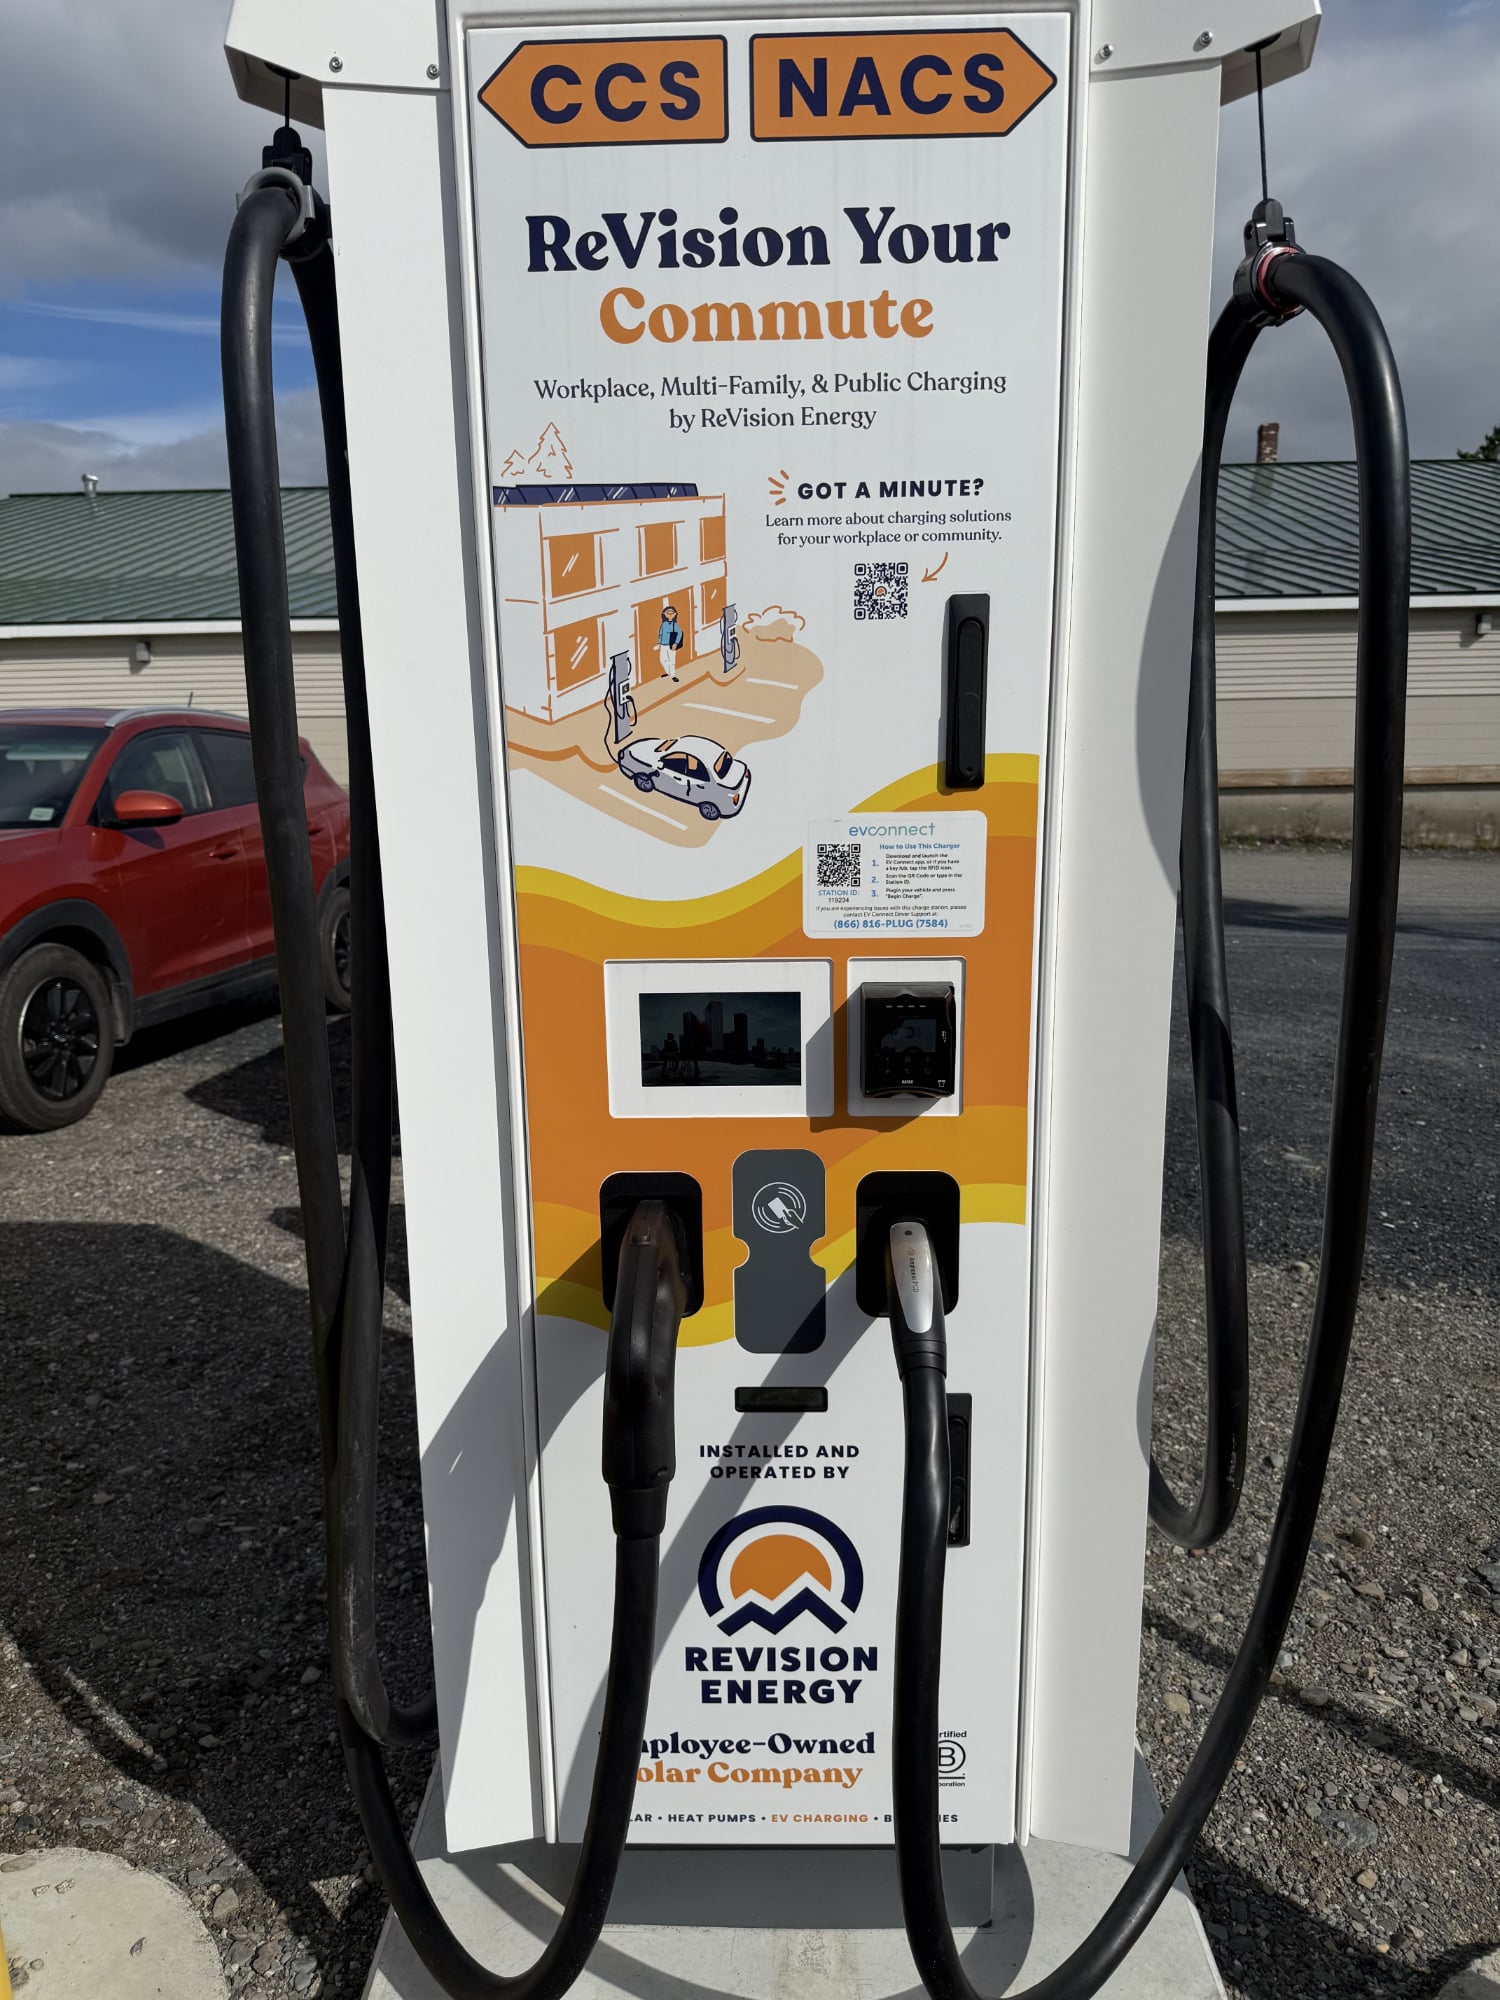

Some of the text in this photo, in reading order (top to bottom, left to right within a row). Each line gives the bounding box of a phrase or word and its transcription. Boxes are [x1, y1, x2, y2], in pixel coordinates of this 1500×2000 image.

[530, 61, 701, 124] CCS
[778, 53, 1006, 119] NACS
[525, 206, 1011, 272] ReVision Your
[600, 287, 934, 344] Commute
[534, 371, 1007, 403] Workplace, Multi-Family, & Public Charging
[669, 407, 877, 432] by ReVision Energy
[797, 478, 984, 500] GOT A MINUTE?
[765, 509, 1012, 527] Learn more about charging solutions
[777, 528, 1002, 547] for your workplace or community.
[848, 822, 936, 837] evconnect
[834, 919, 860, 929] (866)
[862, 919, 914, 928] 816-PLUG
[916, 919, 948, 928] (7584)
[699, 1444, 860, 1458] INSTALLED AND
[710, 1466, 849, 1480] OPERATED BY
[685, 1646, 878, 1672] REVISION
[700, 1679, 862, 1704] ENERGY
[641, 1731, 875, 1759] ployee-Owned
[938, 1730, 967, 1738] rtified
[637, 1760, 863, 1789] olar Company
[668, 1814, 869, 1823] HEAT PUMPS EV CHARGING
